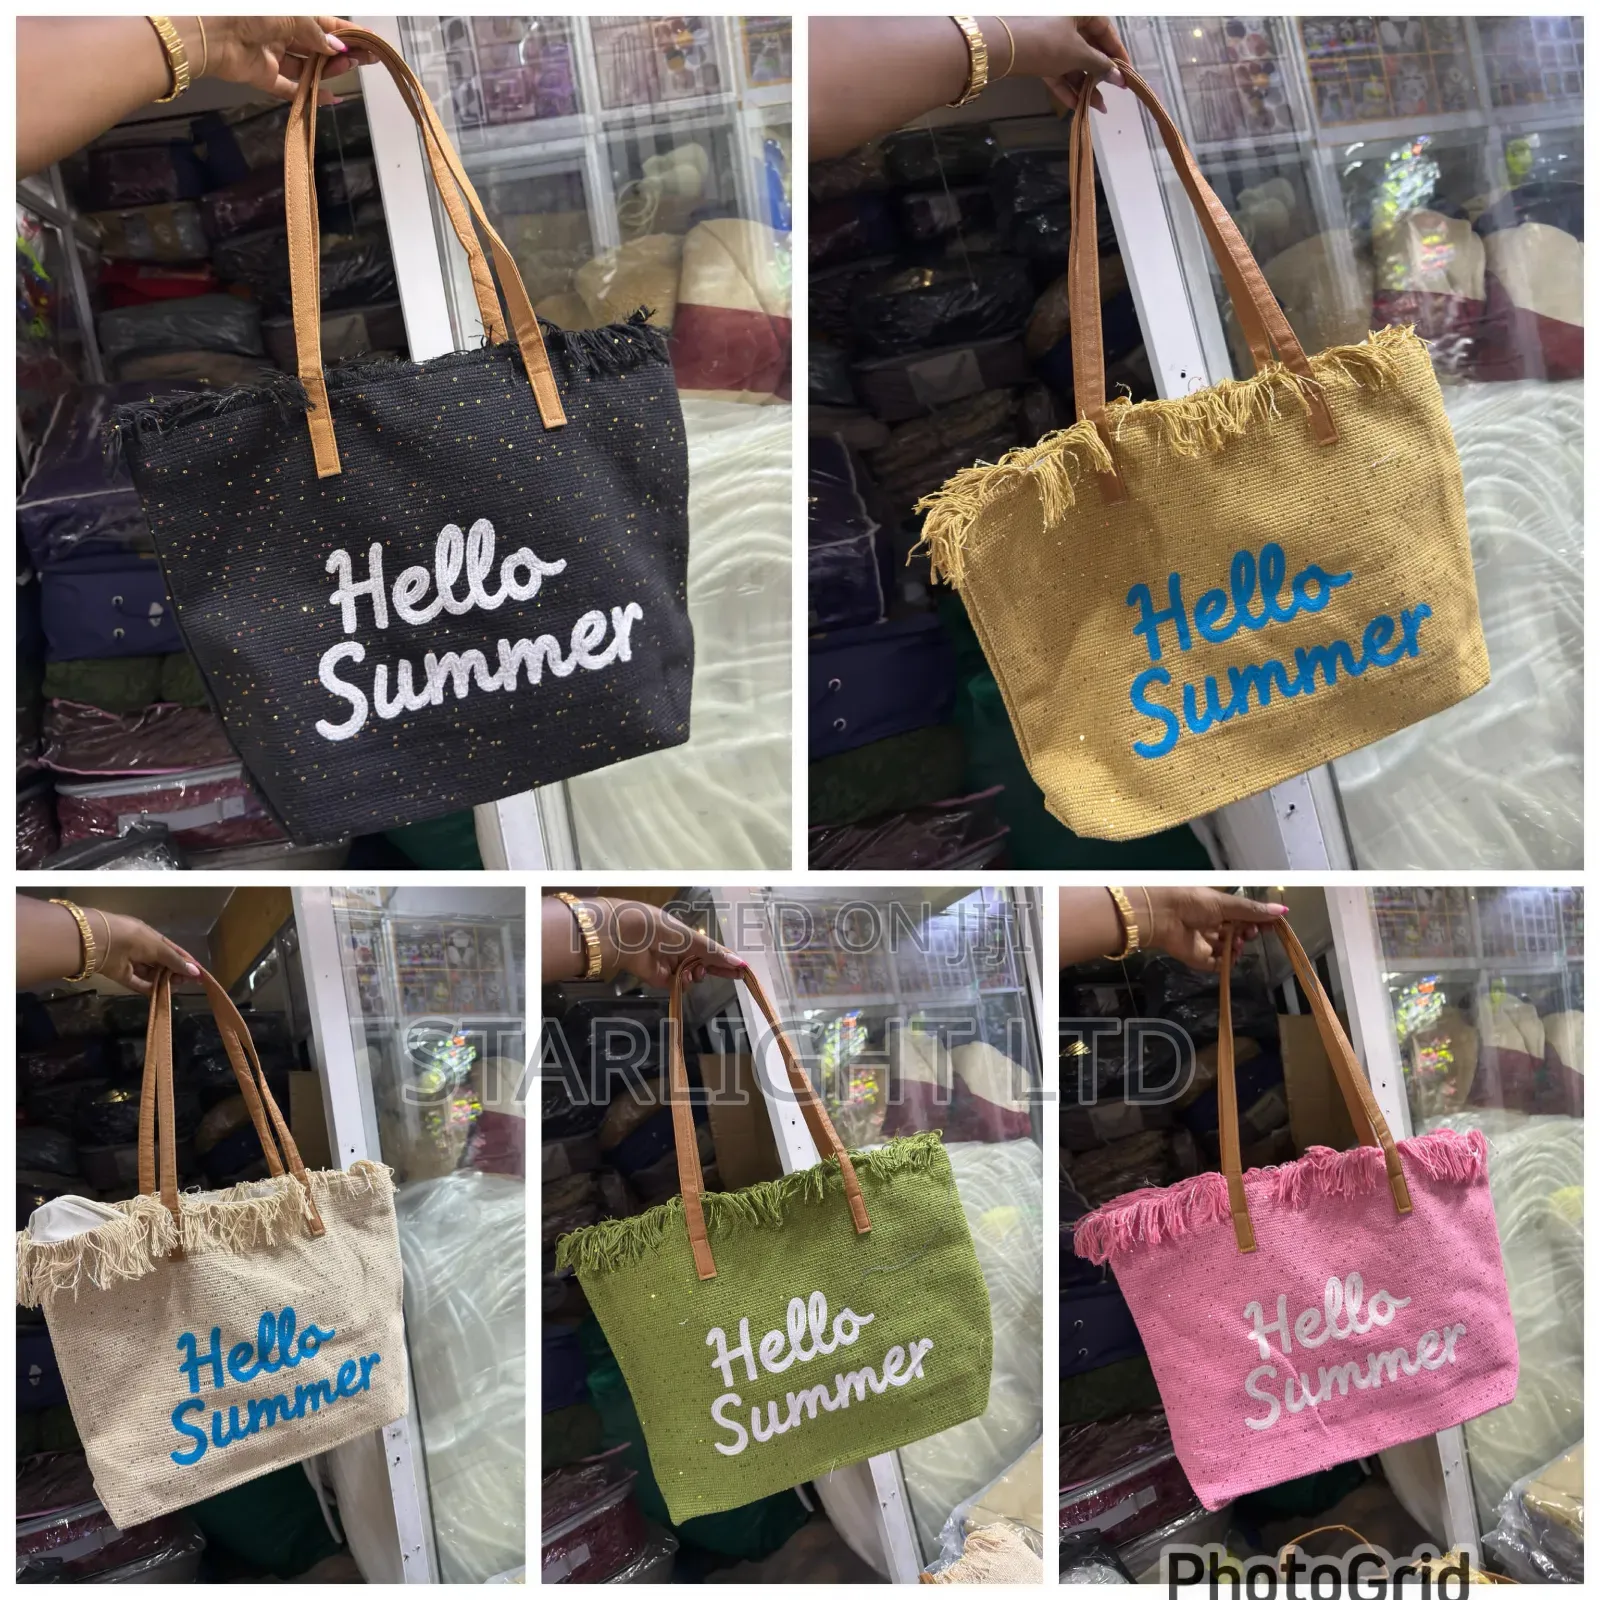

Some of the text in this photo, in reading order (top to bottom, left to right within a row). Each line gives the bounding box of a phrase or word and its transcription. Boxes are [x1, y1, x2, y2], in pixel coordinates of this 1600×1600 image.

[322, 517, 567, 634] Hello
[1126, 542, 1353, 661] Hello
[315, 602, 643, 741] Summer
[1130, 603, 1432, 760] Summer
[177, 1306, 336, 1394] Hello
[705, 1290, 875, 1388] Hello
[1243, 1272, 1411, 1358] Hello
[171, 1353, 381, 1466] Summer
[711, 1337, 934, 1456] Summer
[1244, 1322, 1467, 1431] Summer
